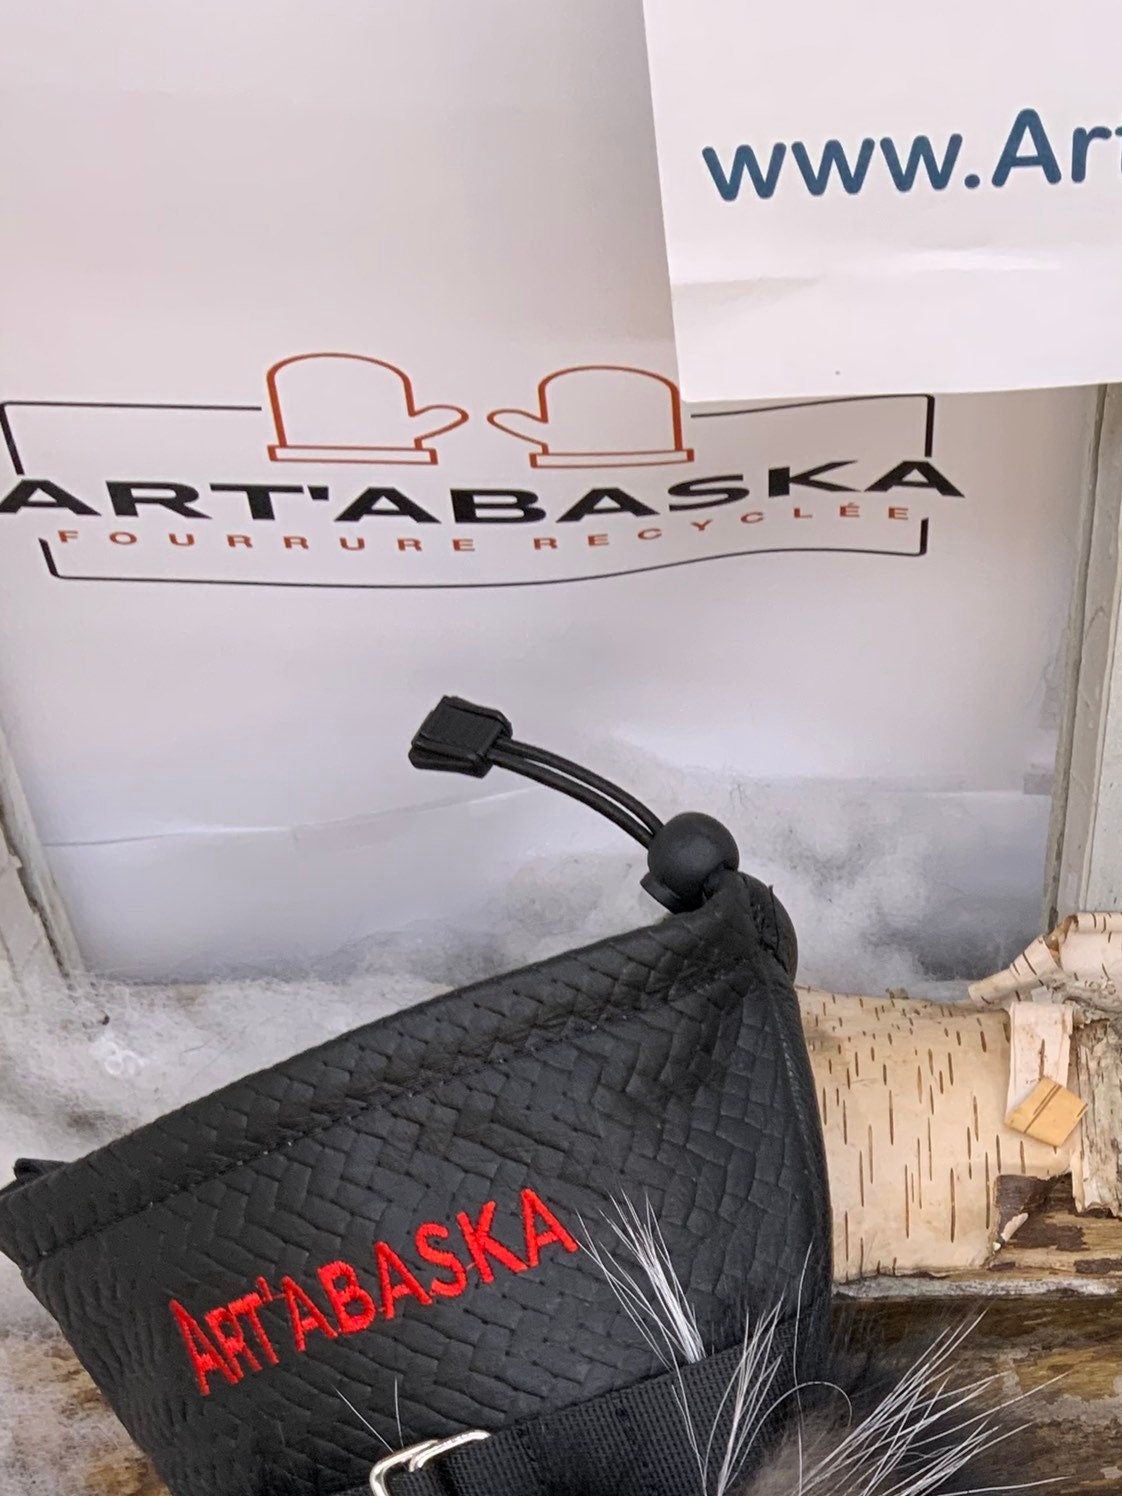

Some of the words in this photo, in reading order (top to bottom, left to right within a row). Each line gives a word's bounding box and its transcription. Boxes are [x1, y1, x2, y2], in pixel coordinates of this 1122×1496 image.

[0, 460, 965, 525] ART'ABASKA
[59, 529, 475, 552] FOURRURE
[534, 500, 911, 550] RECYCLÉE
[169, 1188, 579, 1396] ART'ABASKA
